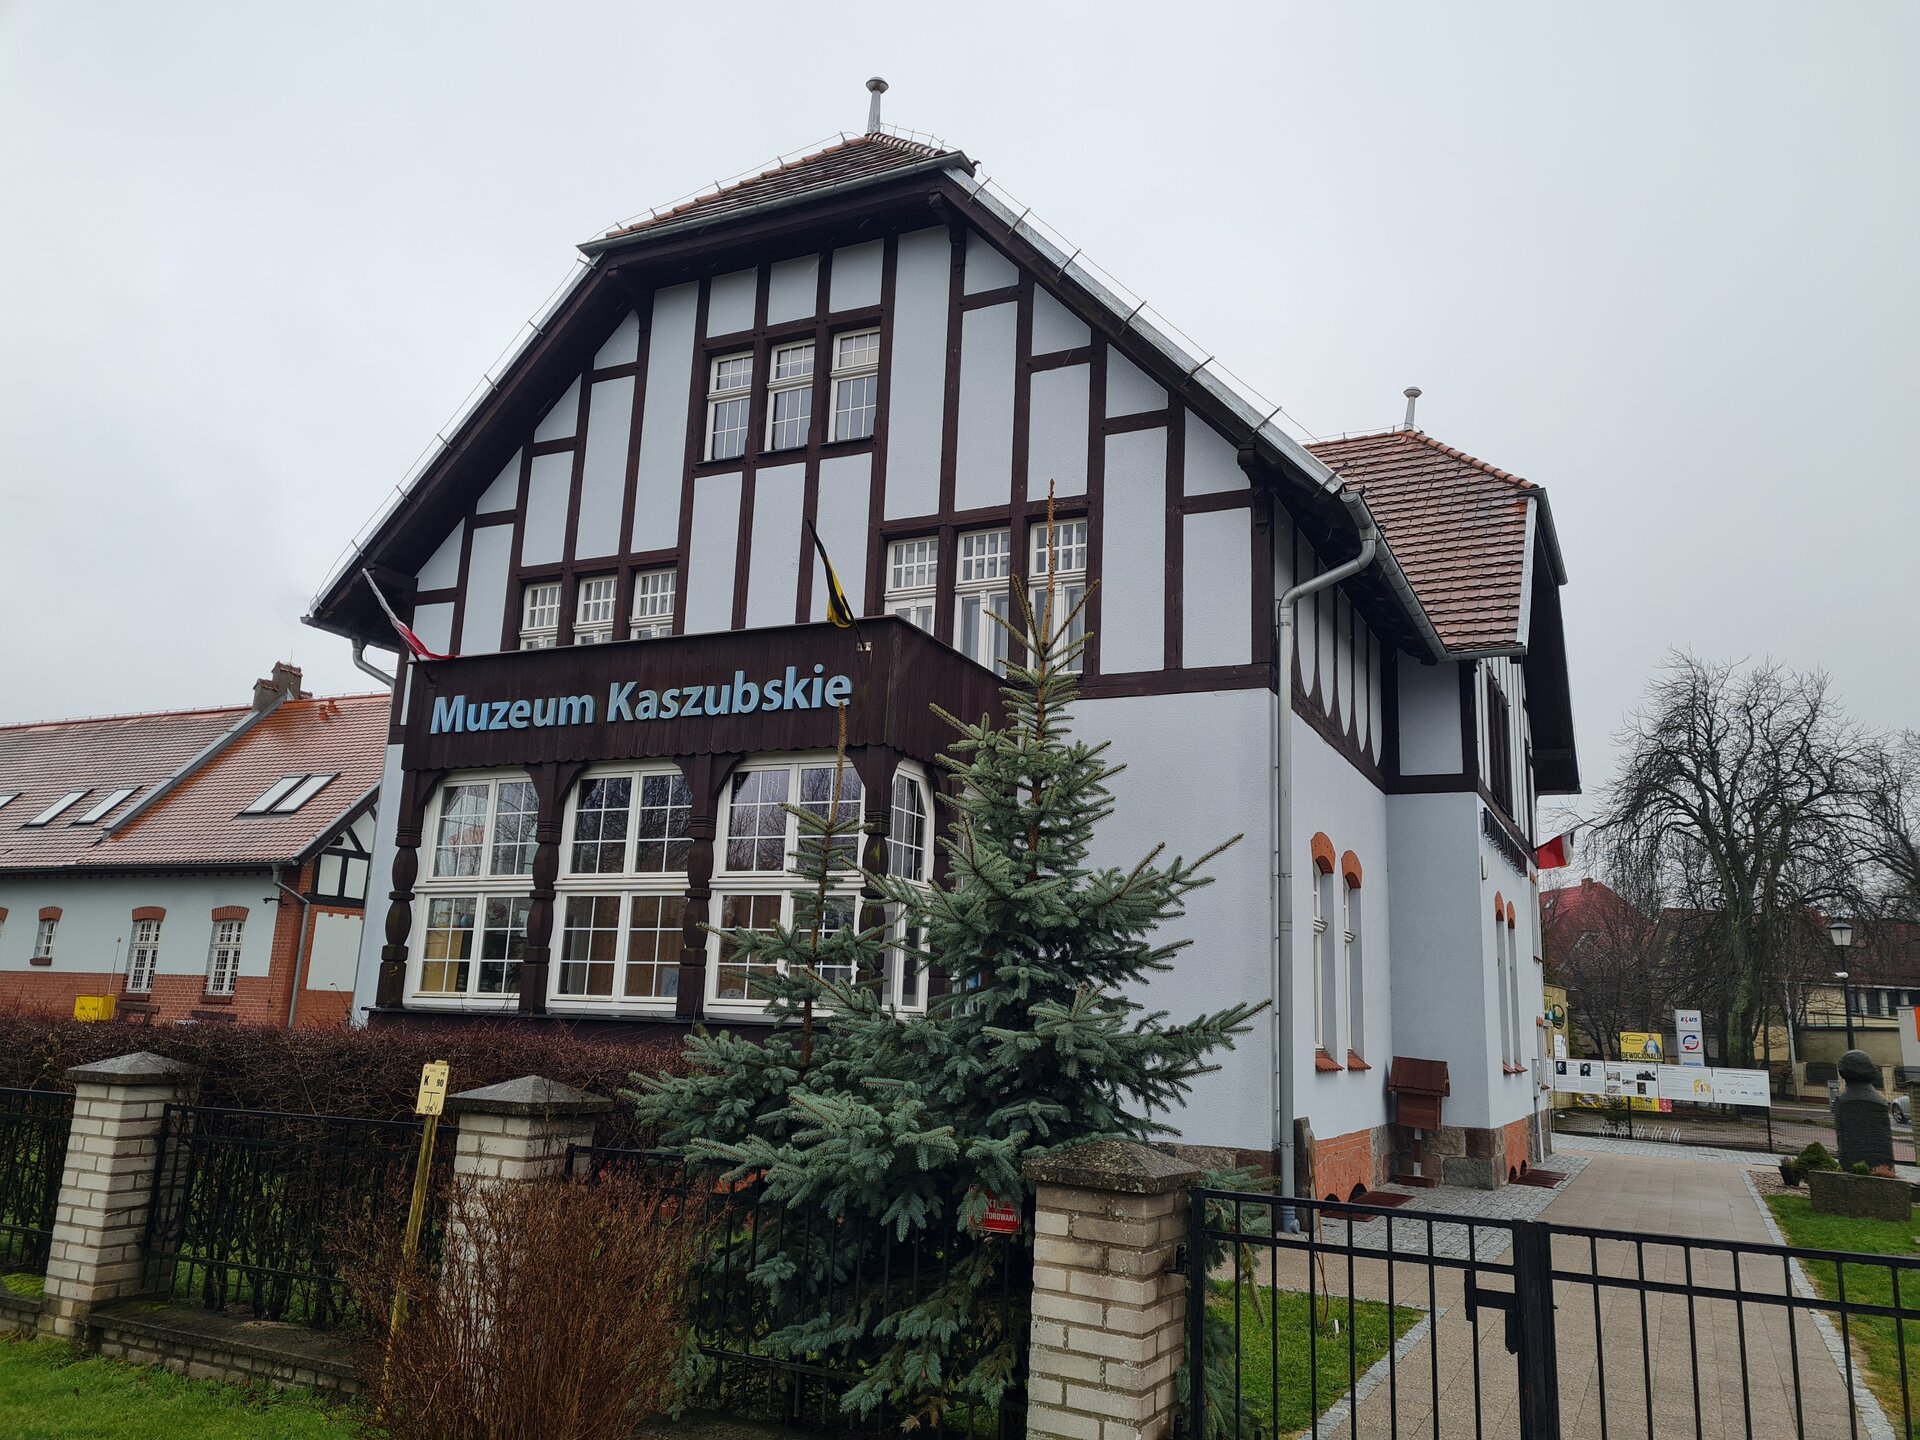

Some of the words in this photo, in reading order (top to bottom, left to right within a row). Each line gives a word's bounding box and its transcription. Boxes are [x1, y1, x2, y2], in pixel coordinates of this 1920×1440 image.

[430, 693, 596, 735] Muzeum
[606, 663, 853, 722] Kaszubskie
[424, 1075, 430, 1086] K
[436, 1079, 444, 1087] 90
